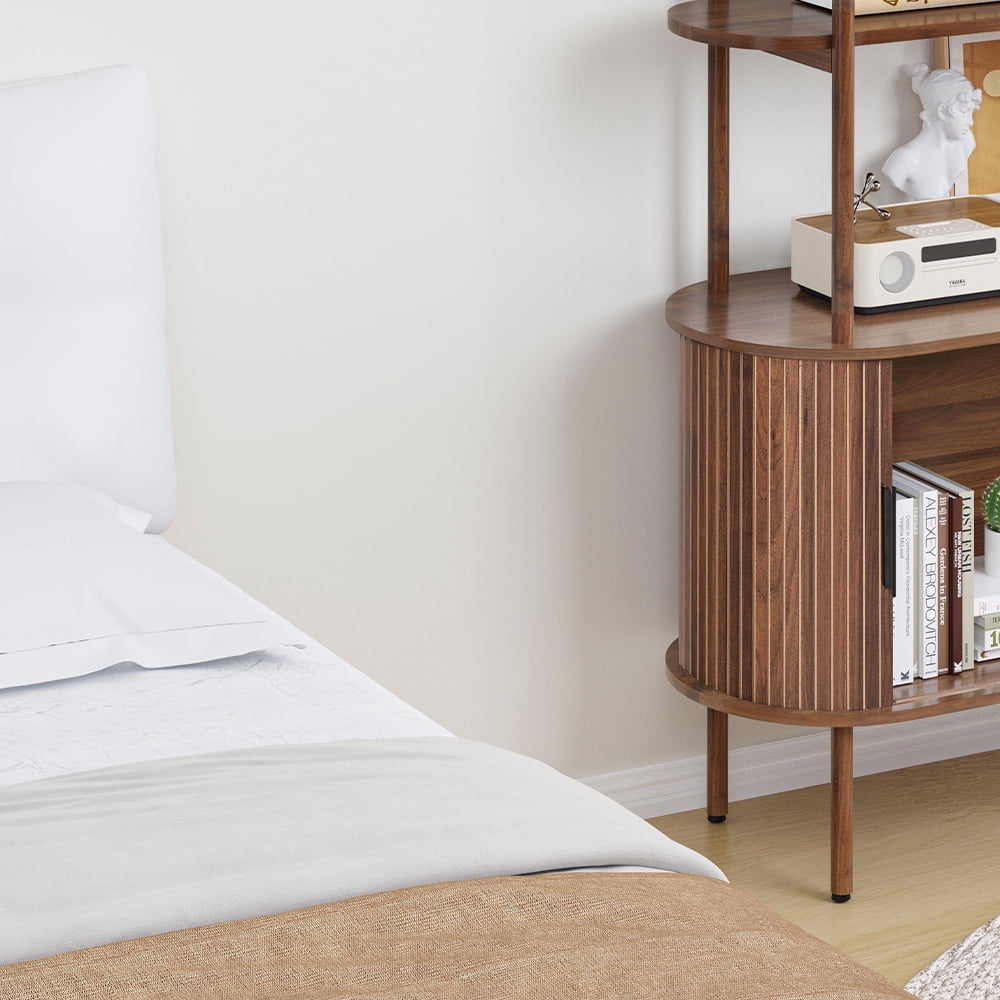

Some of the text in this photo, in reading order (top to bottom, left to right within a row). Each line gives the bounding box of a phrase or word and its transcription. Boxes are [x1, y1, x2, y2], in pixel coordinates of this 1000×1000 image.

[925, 497, 937, 557] ALEXEY
[962, 496, 972, 573] LOST FISH
[925, 562, 937, 667] BRODOVITCH
[939, 596, 947, 626] France
[940, 585, 947, 594] in
